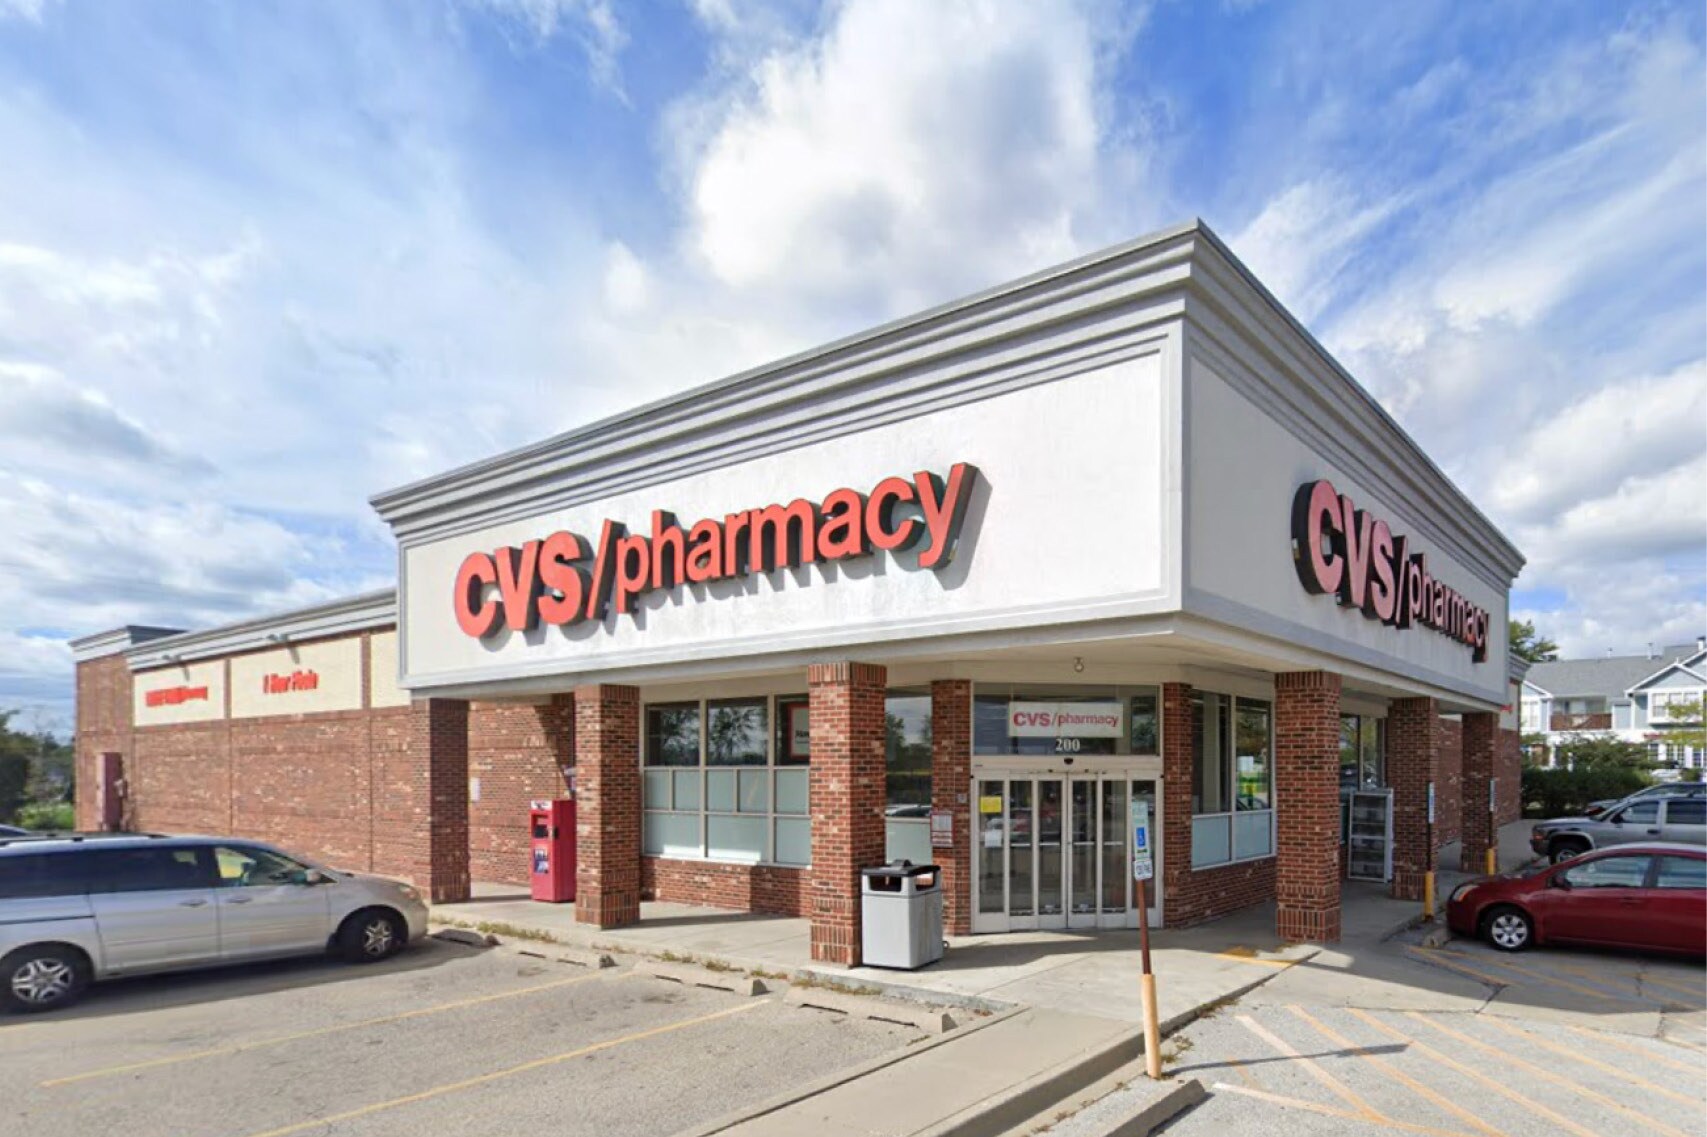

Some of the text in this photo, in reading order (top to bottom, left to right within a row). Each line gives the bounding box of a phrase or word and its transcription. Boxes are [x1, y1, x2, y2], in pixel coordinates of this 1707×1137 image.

[454, 462, 976, 639] CVS/pharmacy
[1292, 479, 1490, 663] CVS/pharmacy
[1013, 711, 1119, 728] CVS/pharmacy
[1055, 738, 1081, 752] 200
